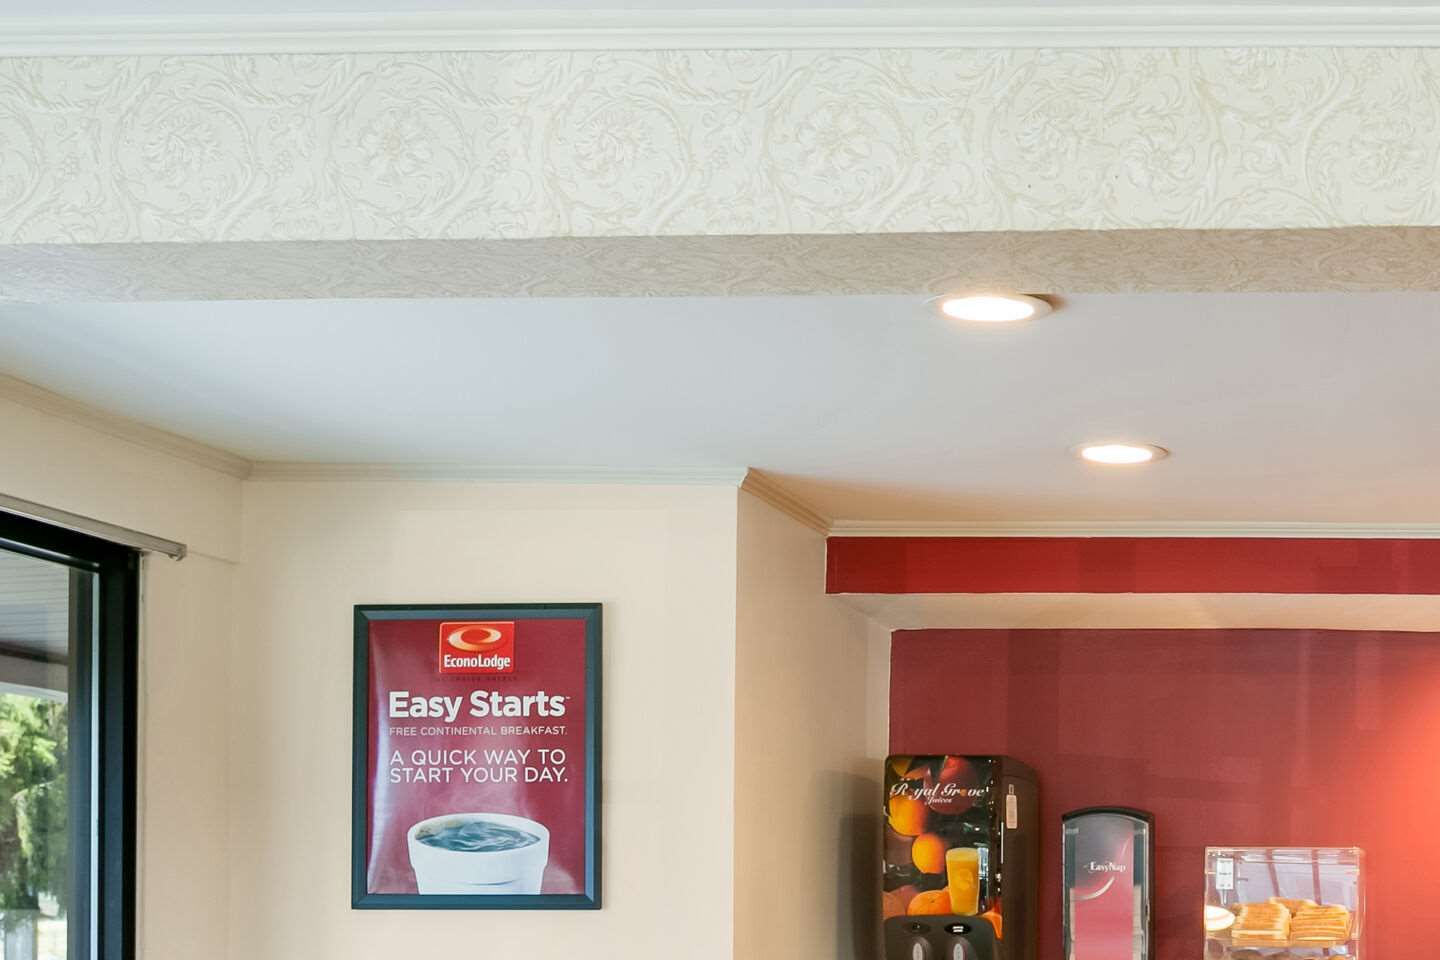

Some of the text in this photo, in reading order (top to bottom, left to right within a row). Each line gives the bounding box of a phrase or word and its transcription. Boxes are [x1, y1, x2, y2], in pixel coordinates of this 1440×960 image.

[444, 654, 511, 670] EconoLodge
[389, 691, 463, 722] Easy
[389, 727, 417, 736] FREE
[420, 726, 497, 736] CONTINENTAL
[390, 749, 566, 766] A QUICK WAY TO
[390, 767, 568, 783] START YOUR DAY.
